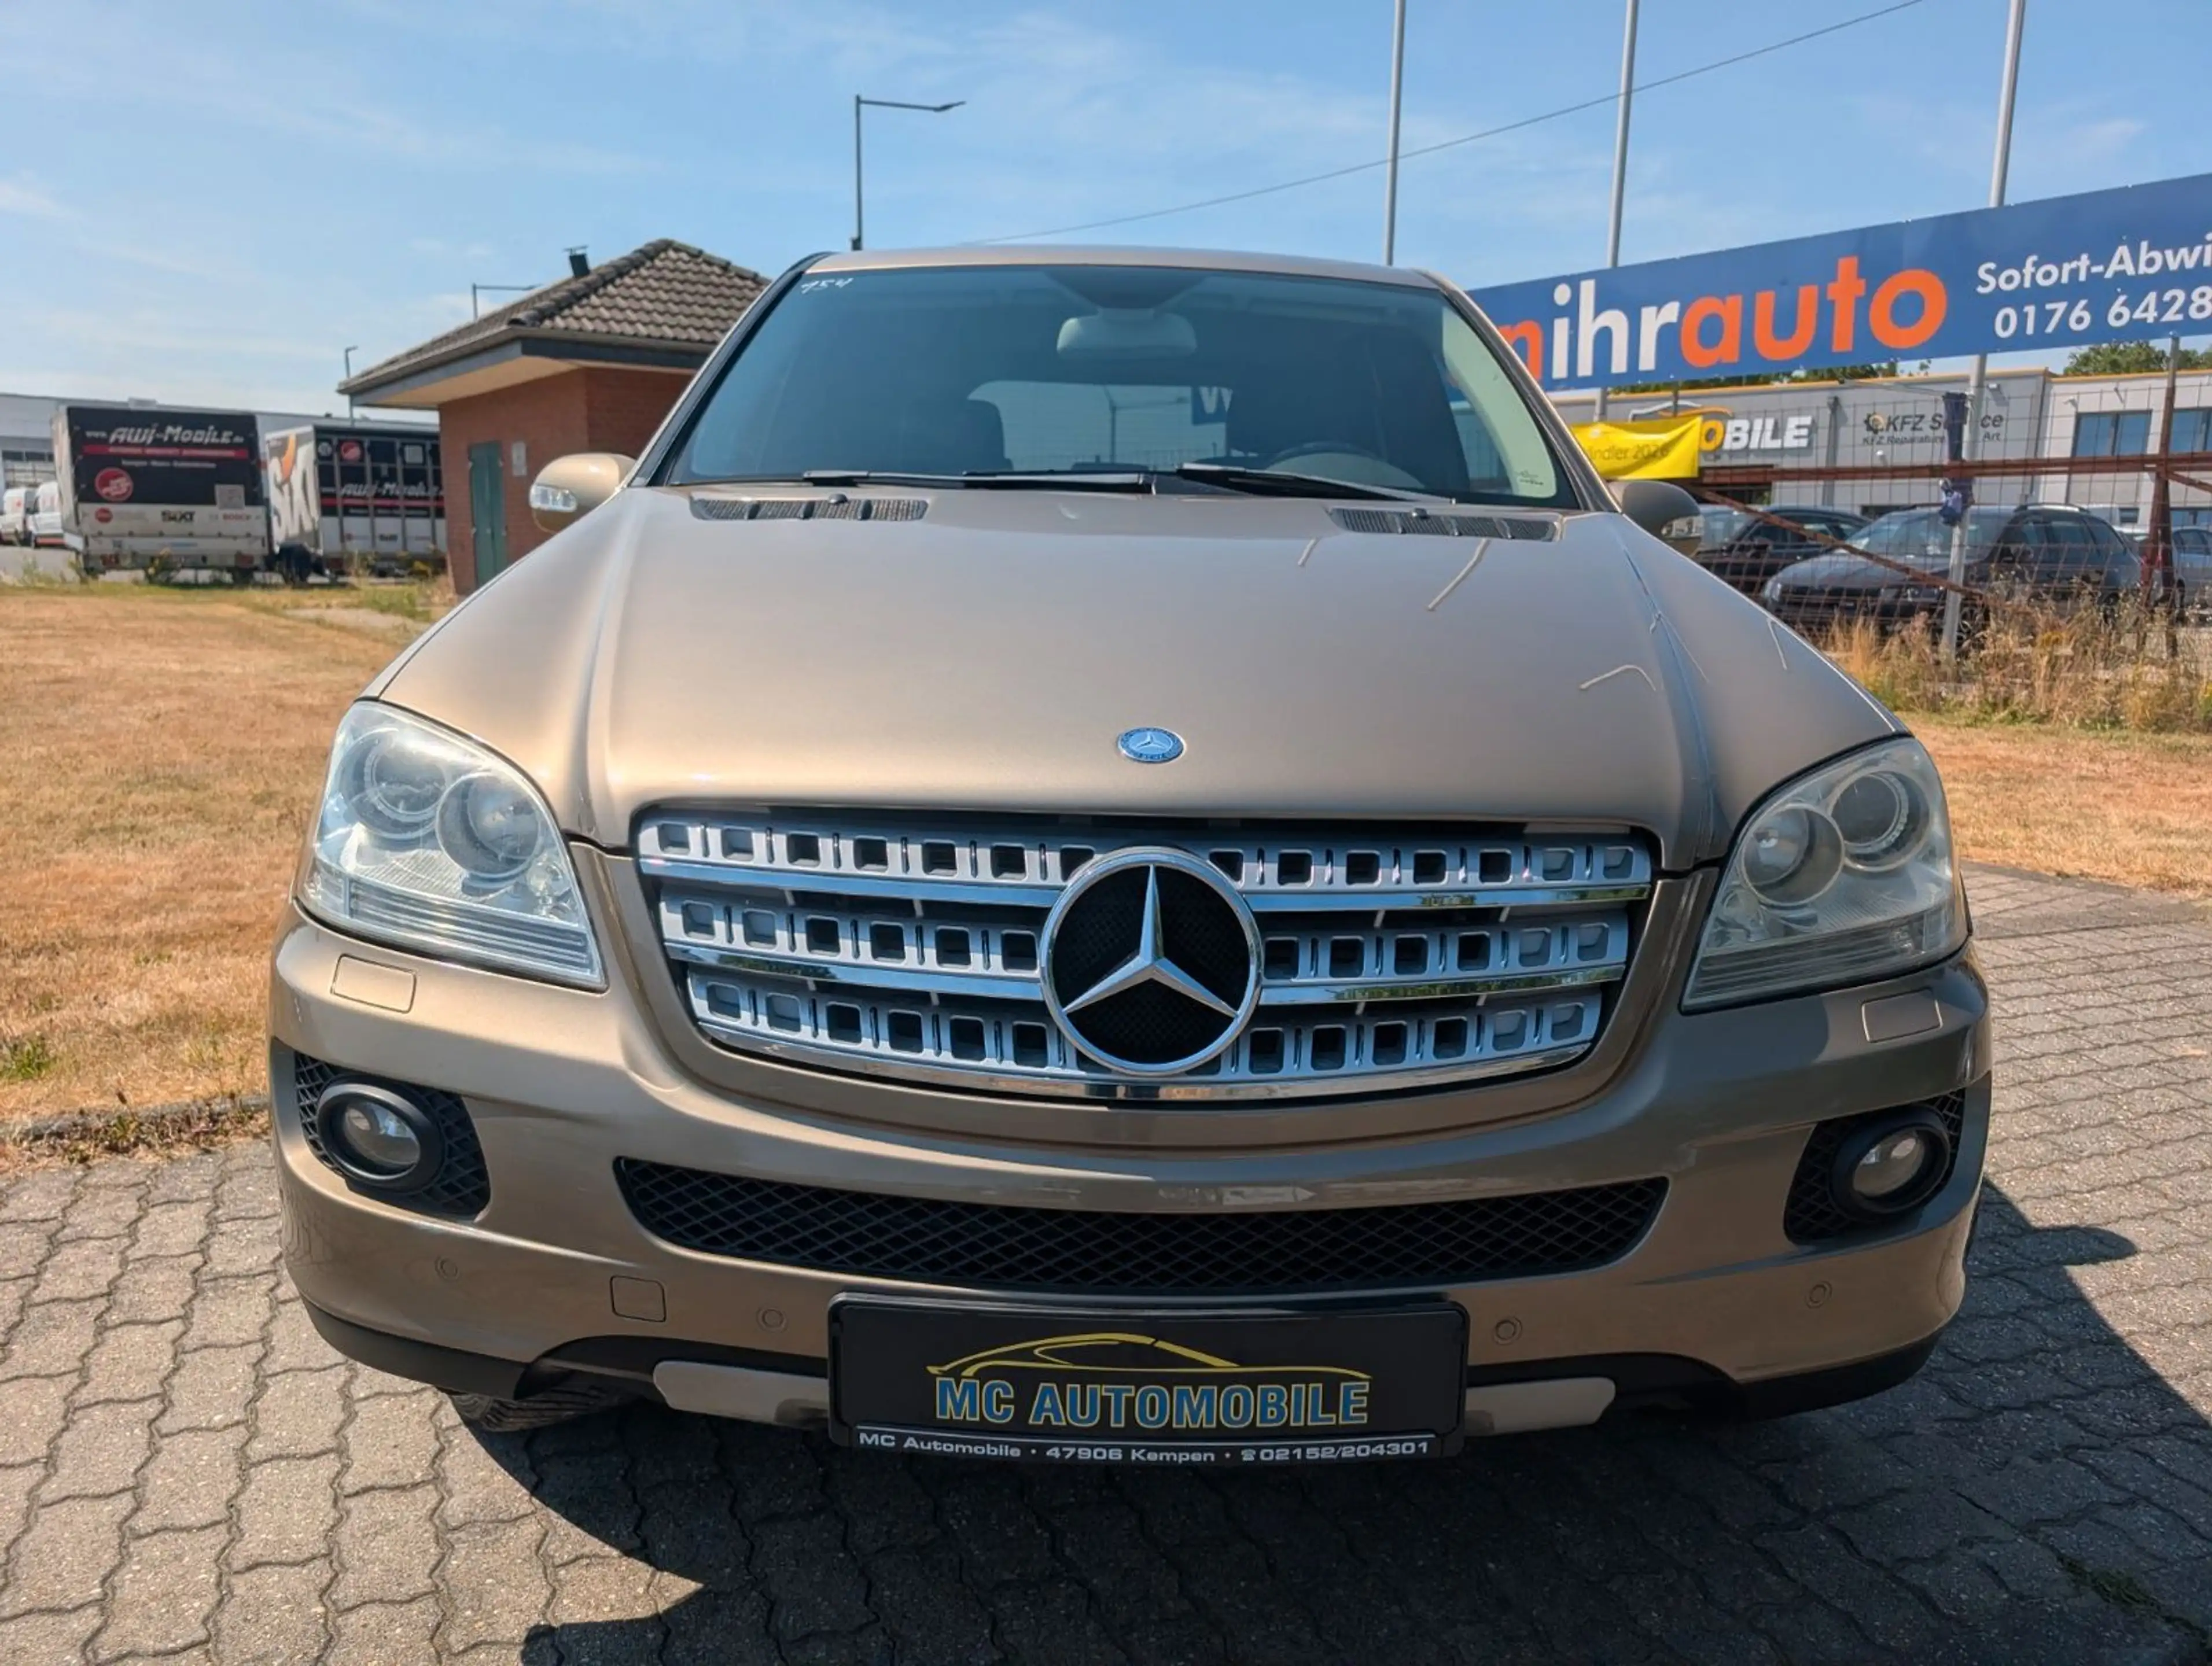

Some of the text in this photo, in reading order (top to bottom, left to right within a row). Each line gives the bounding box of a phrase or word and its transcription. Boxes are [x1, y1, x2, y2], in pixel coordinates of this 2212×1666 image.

[1994, 285, 2212, 338] 0176 6428
[1699, 415, 1813, 452] OBILE
[1886, 414, 1926, 432] KFZ
[935, 1377, 1370, 1429] MC AUTOMOBILE
[859, 1433, 1430, 1464] MC Automobile 47906 Kempen 02152/204301
